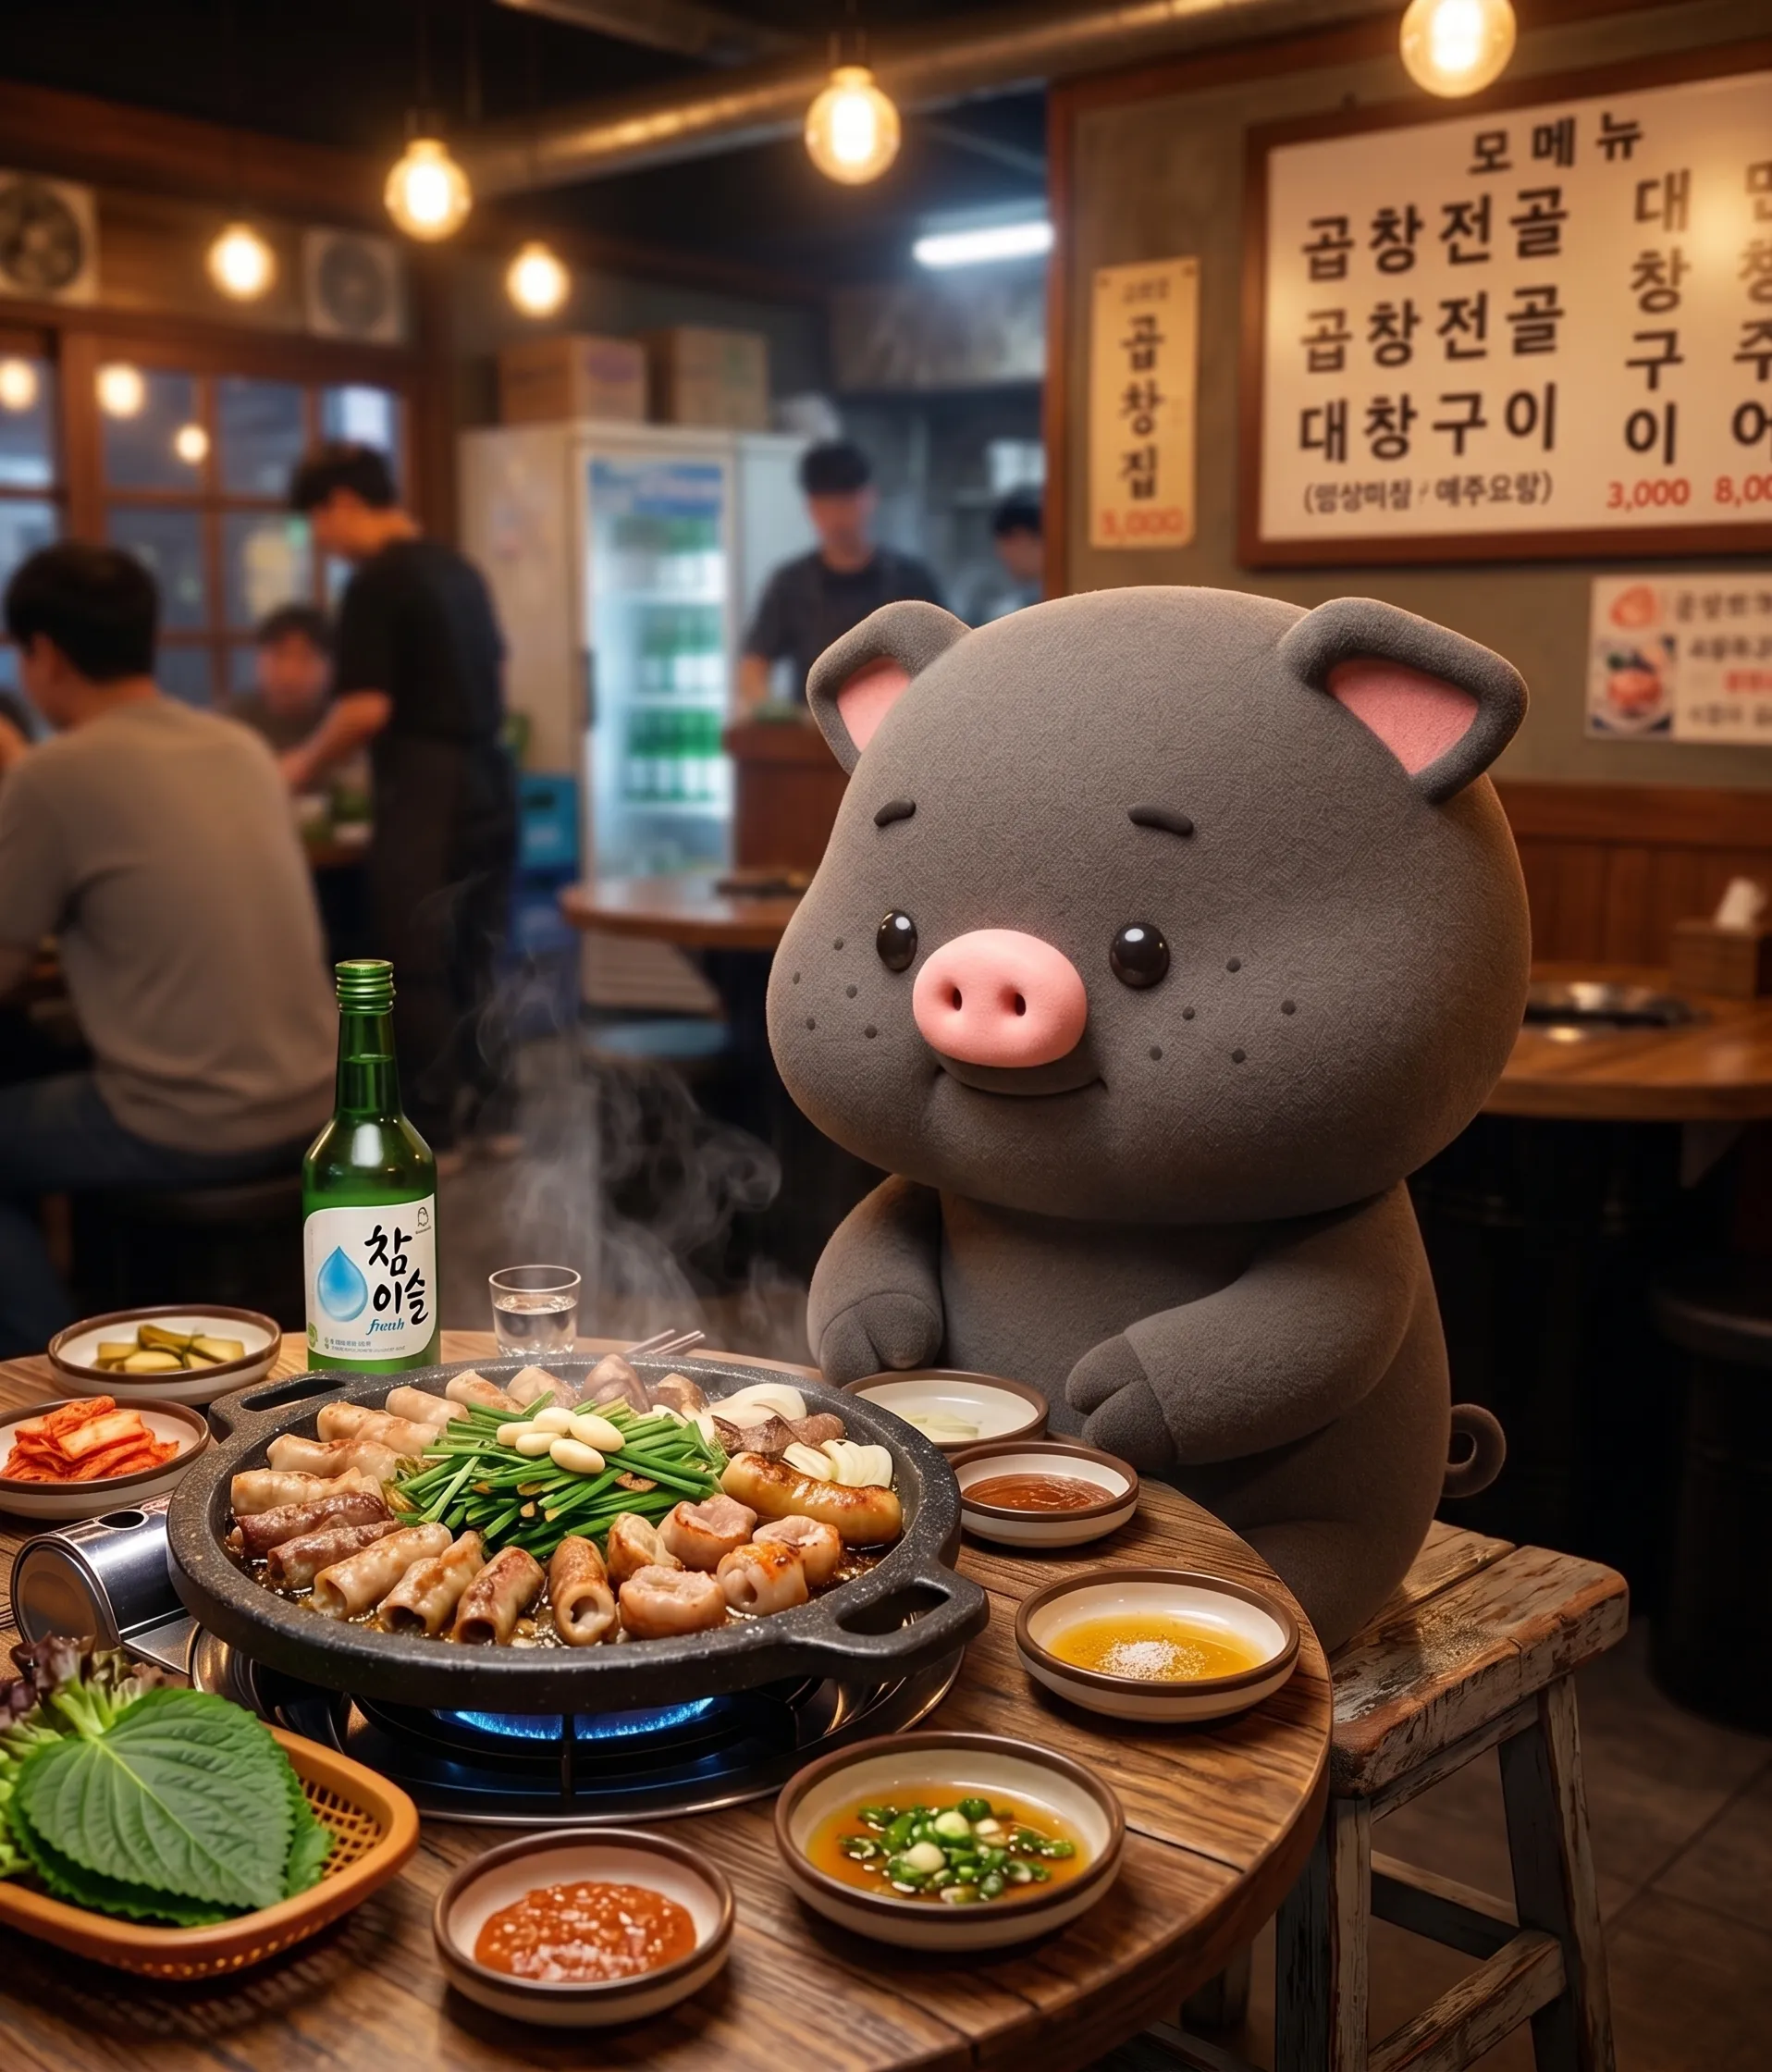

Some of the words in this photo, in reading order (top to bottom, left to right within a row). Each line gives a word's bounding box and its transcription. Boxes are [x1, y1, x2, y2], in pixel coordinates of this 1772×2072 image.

[1301, 188, 1568, 281] 곱창전골
[1300, 286, 1564, 373] 곱창전골
[1299, 383, 1556, 462] 대창구이
[1607, 478, 1691, 512] 3,000
[364, 1224, 412, 1276] 참
[373, 1268, 428, 1326] 이슬
